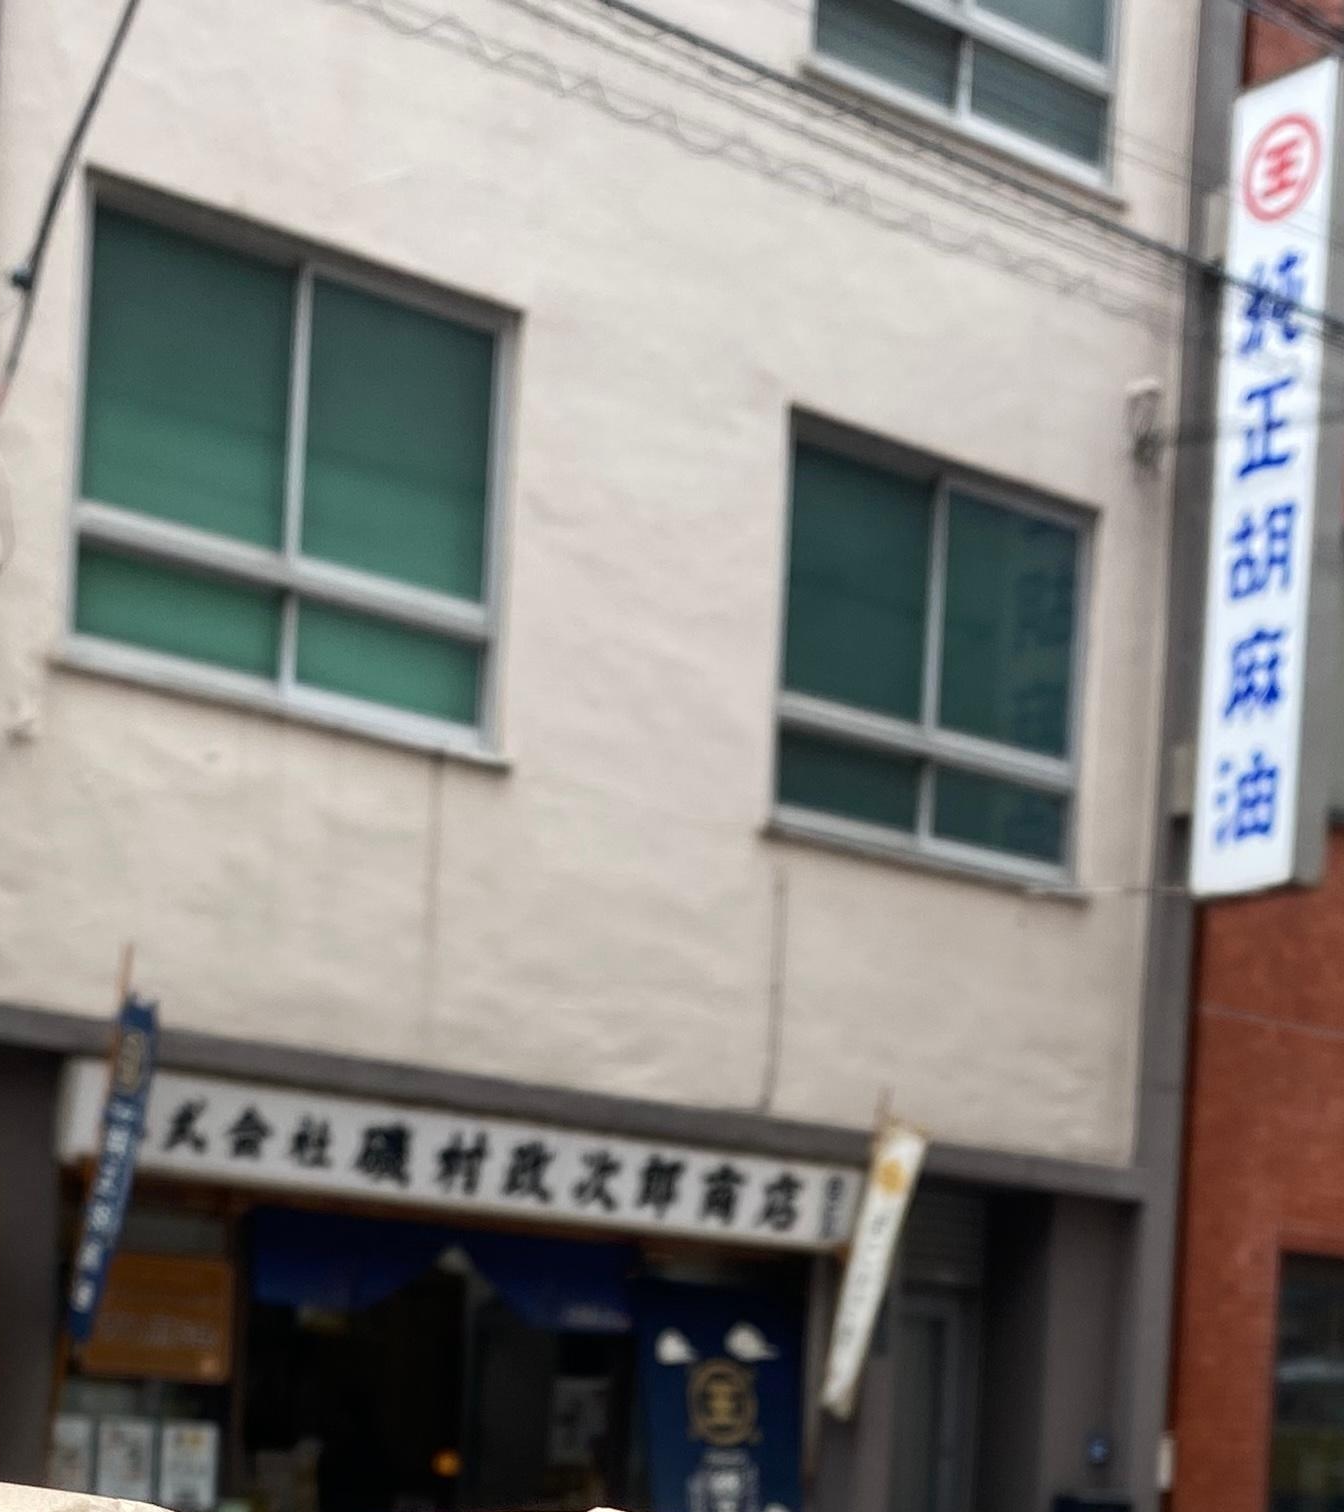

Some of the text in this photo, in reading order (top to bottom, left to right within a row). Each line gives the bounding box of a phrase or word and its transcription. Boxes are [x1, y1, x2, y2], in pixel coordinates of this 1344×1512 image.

[150, 1098, 805, 1233] 式会社磯村政次郎商店
